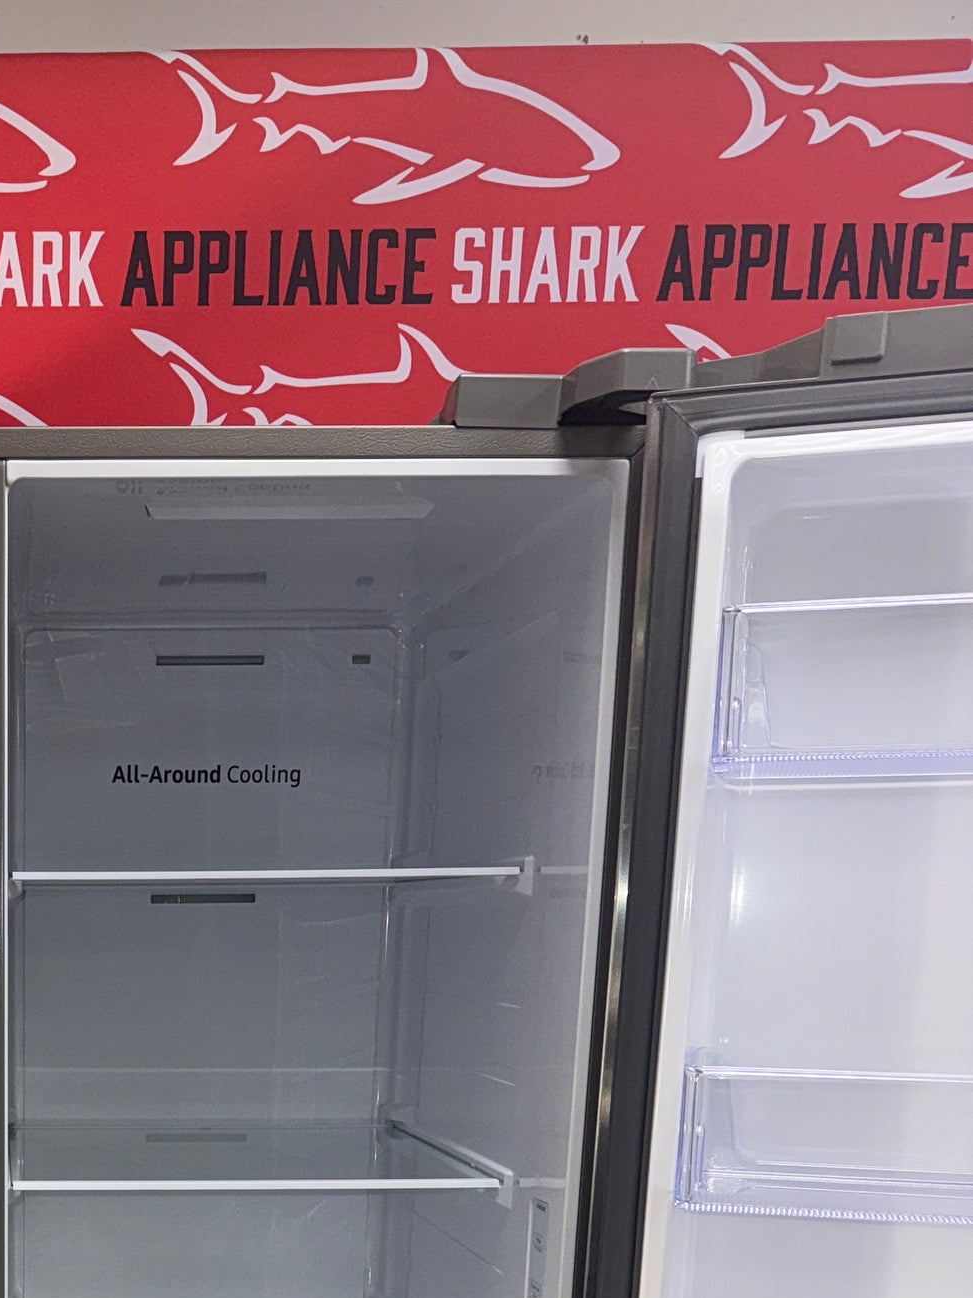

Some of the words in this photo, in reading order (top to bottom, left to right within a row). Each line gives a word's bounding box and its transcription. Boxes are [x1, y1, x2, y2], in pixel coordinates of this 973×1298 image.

[119, 228, 437, 307] APPLIANCE
[450, 226, 646, 304] SHARK
[655, 222, 973, 301] APPLIANCE
[112, 764, 221, 784] All-Around
[227, 764, 301, 788] Cooling
